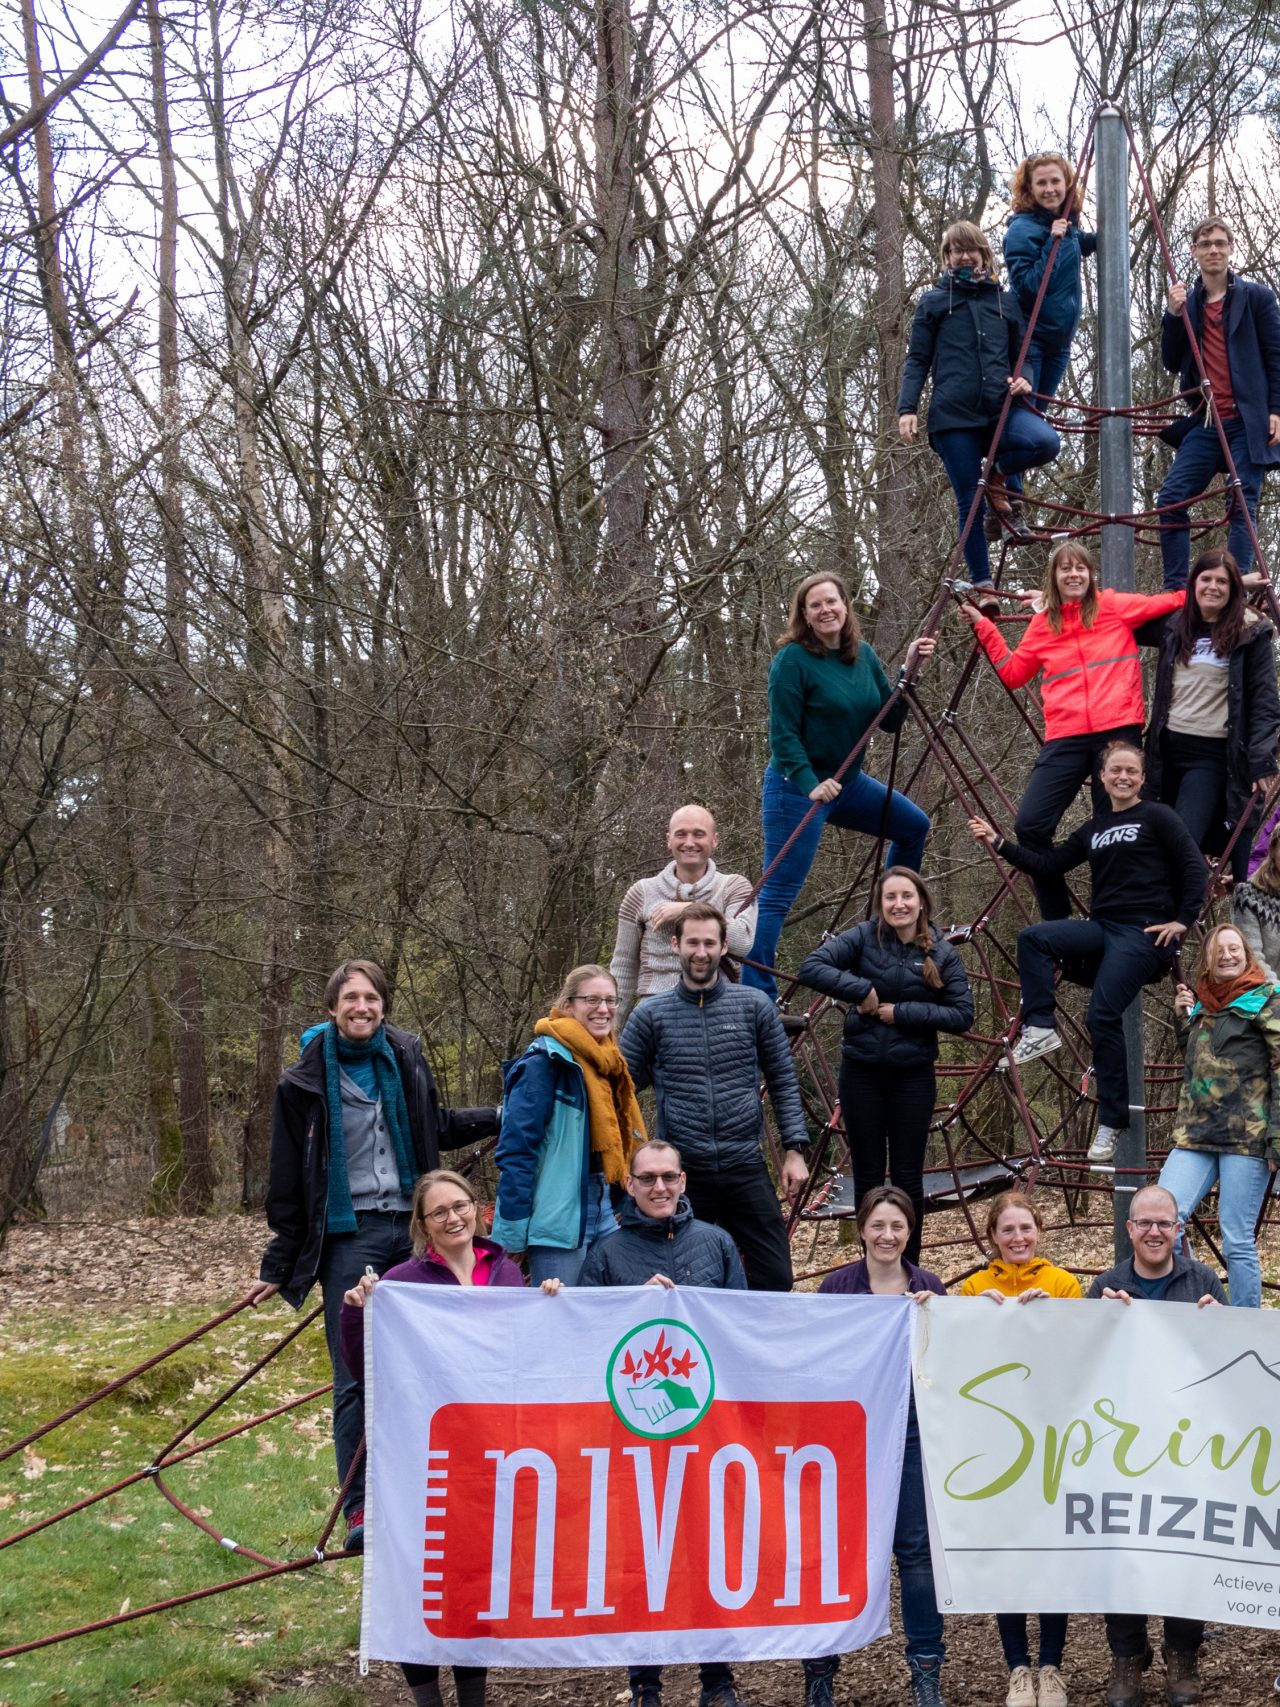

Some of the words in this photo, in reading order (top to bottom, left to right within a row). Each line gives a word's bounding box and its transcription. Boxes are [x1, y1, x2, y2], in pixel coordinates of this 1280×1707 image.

[1091, 824, 1142, 850] VANS
[477, 1443, 851, 1621] nivon
[1213, 1573, 1273, 1593] Actieve
[1226, 1600, 1263, 1615] voor
